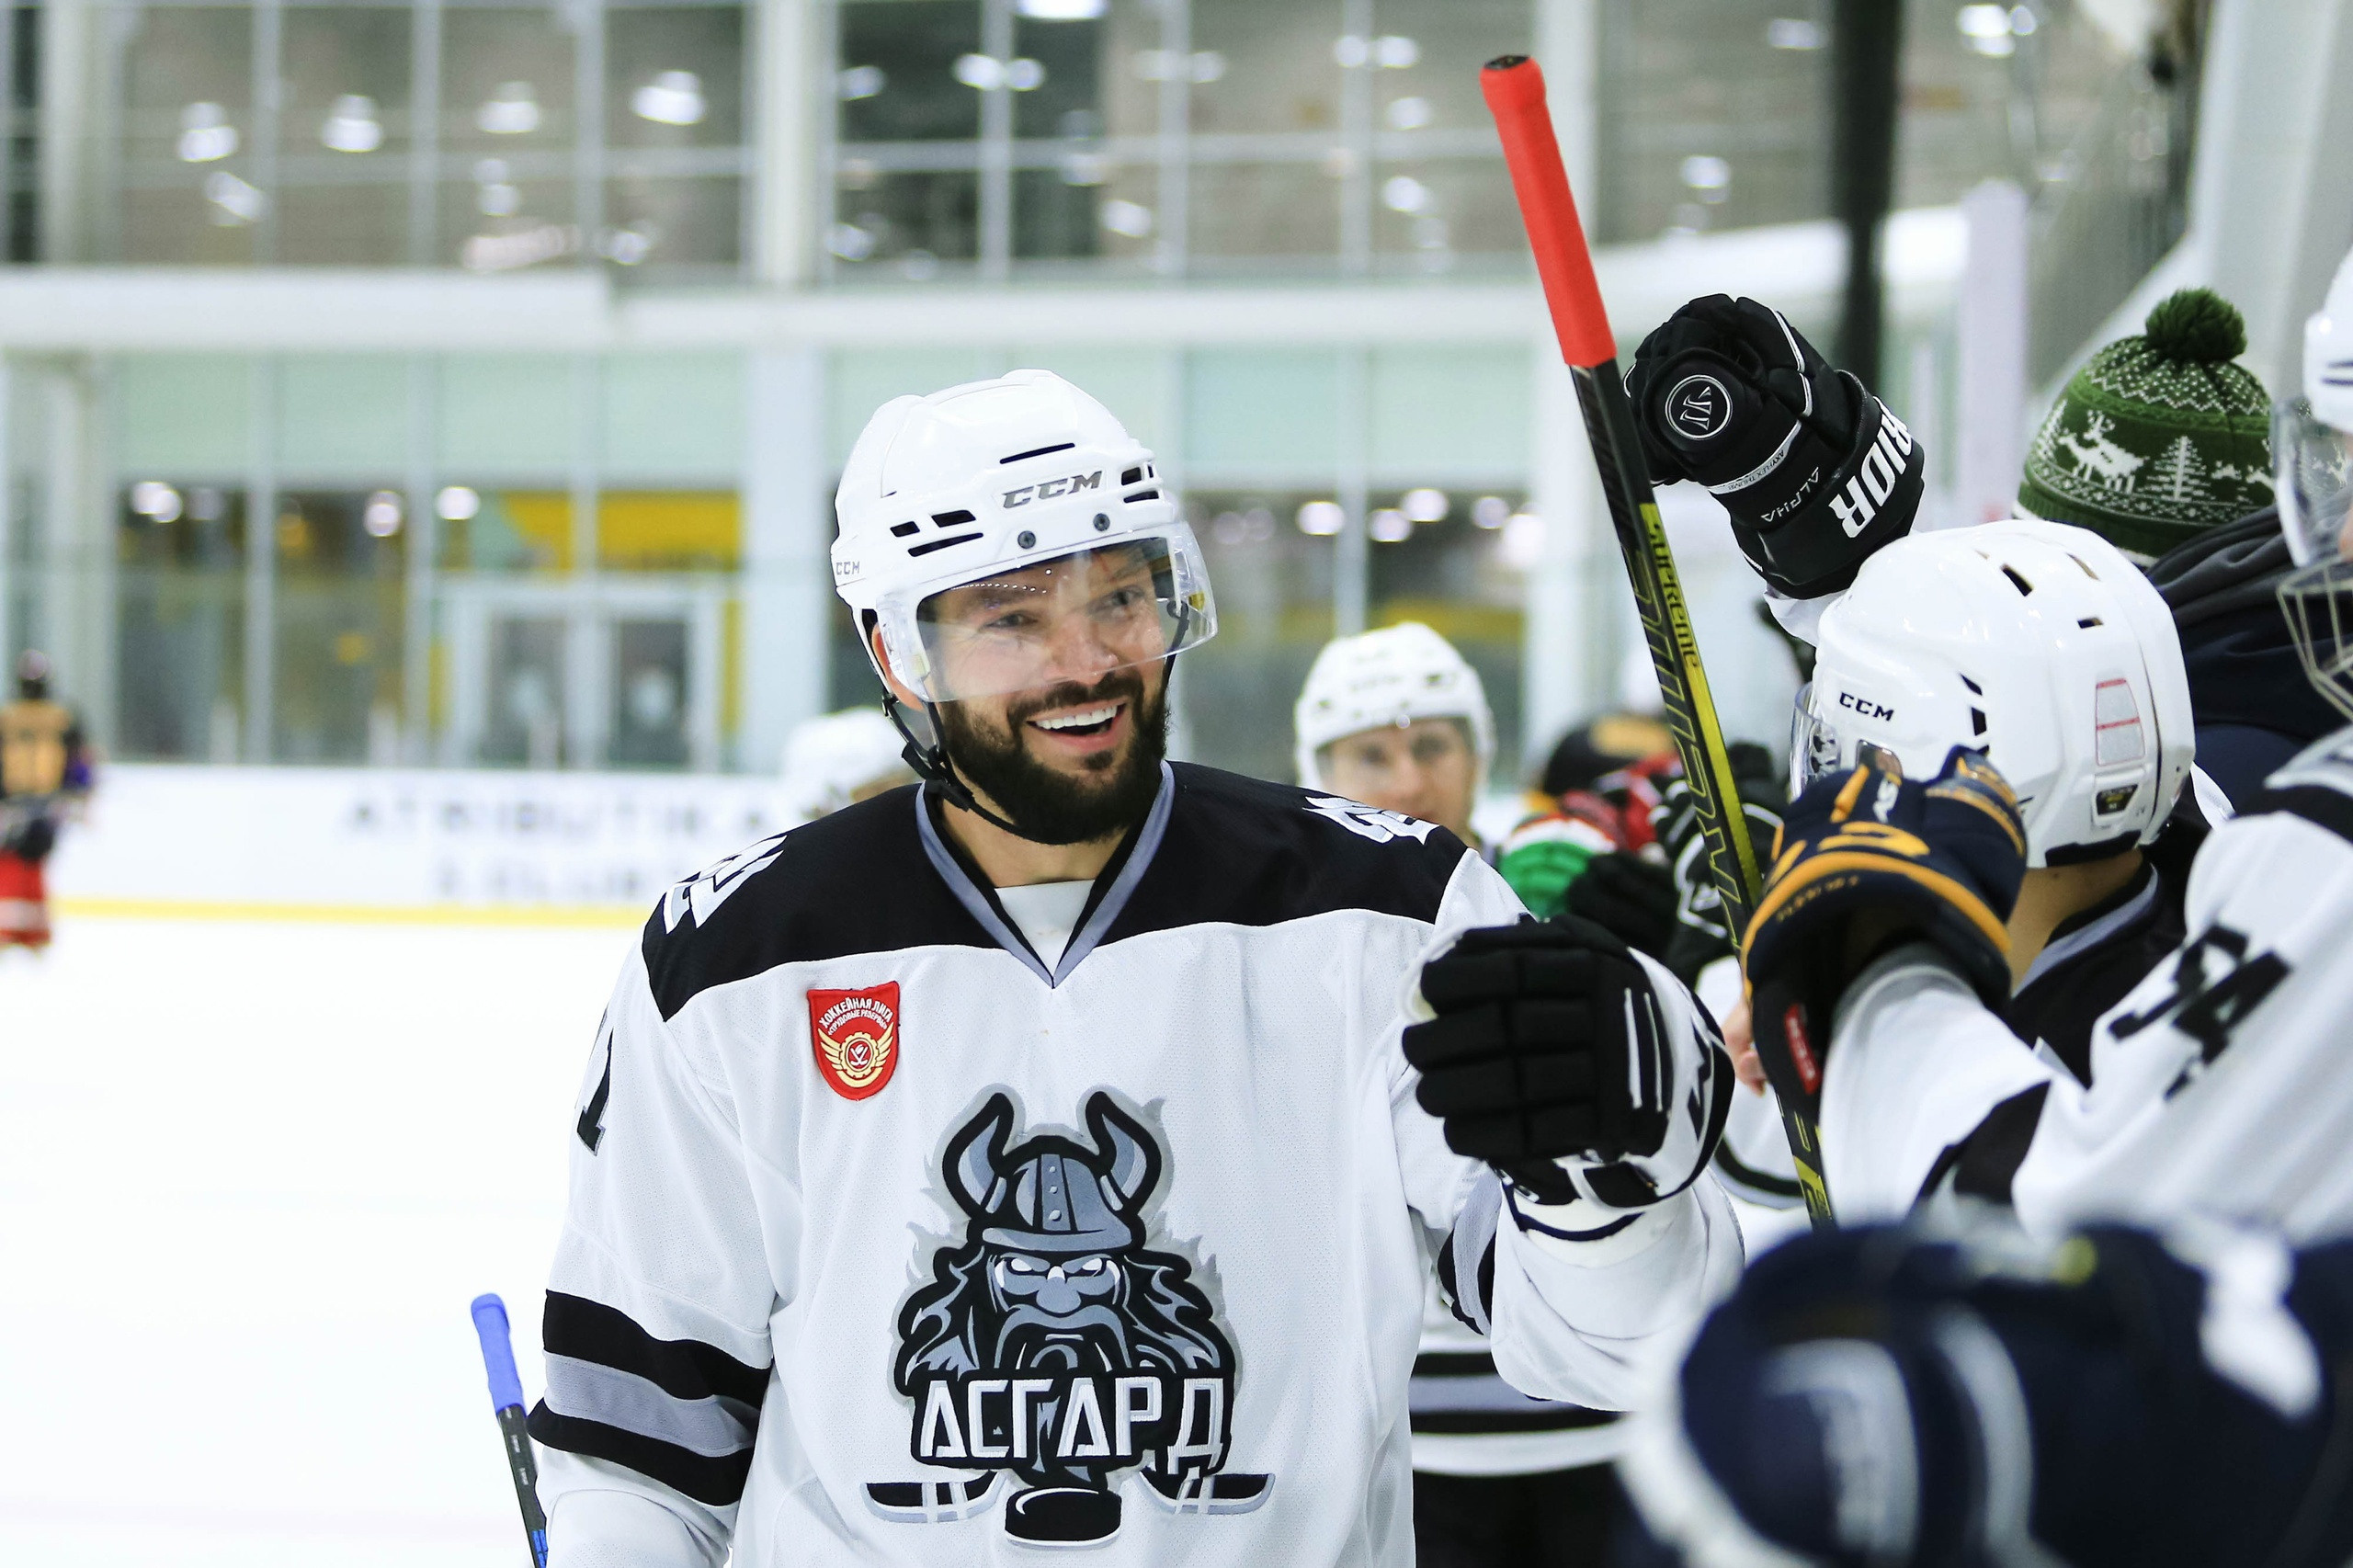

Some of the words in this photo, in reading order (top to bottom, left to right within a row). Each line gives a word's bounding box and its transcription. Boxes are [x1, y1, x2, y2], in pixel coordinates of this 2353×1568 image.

[1829, 395, 1913, 539] RIOR
[1003, 471, 1102, 508] CCM
[1760, 466, 1819, 522] ALPHA
[835, 562, 860, 575] CCM
[1839, 691, 1894, 722] CCM
[819, 997, 872, 1028] ХОККЕЙНАЯ
[871, 1000, 893, 1023] ЛИГА
[919, 1376, 1224, 1475] АСГАРД
